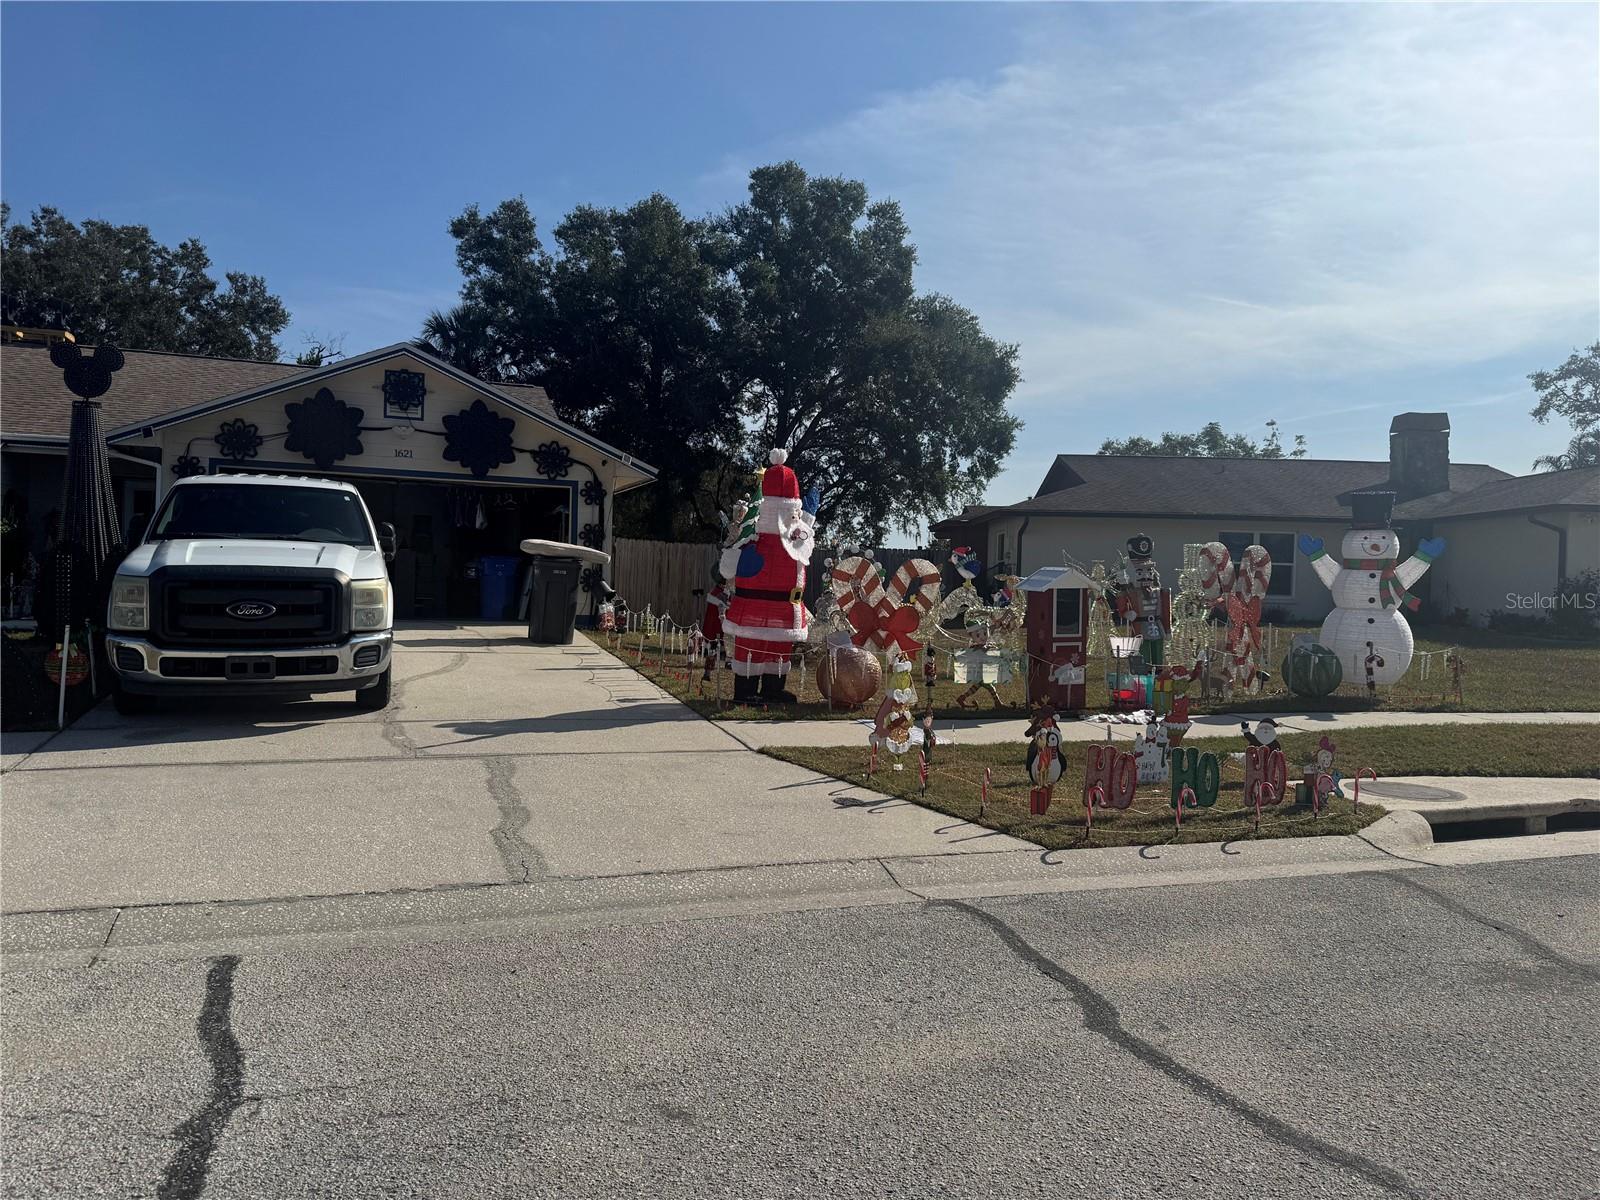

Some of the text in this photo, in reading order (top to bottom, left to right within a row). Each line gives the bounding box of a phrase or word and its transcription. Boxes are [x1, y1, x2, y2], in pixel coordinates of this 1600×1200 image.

[393, 448, 413, 458] 1621
[237, 604, 264, 615] Ford
[1083, 744, 1287, 809] HO HO HO
